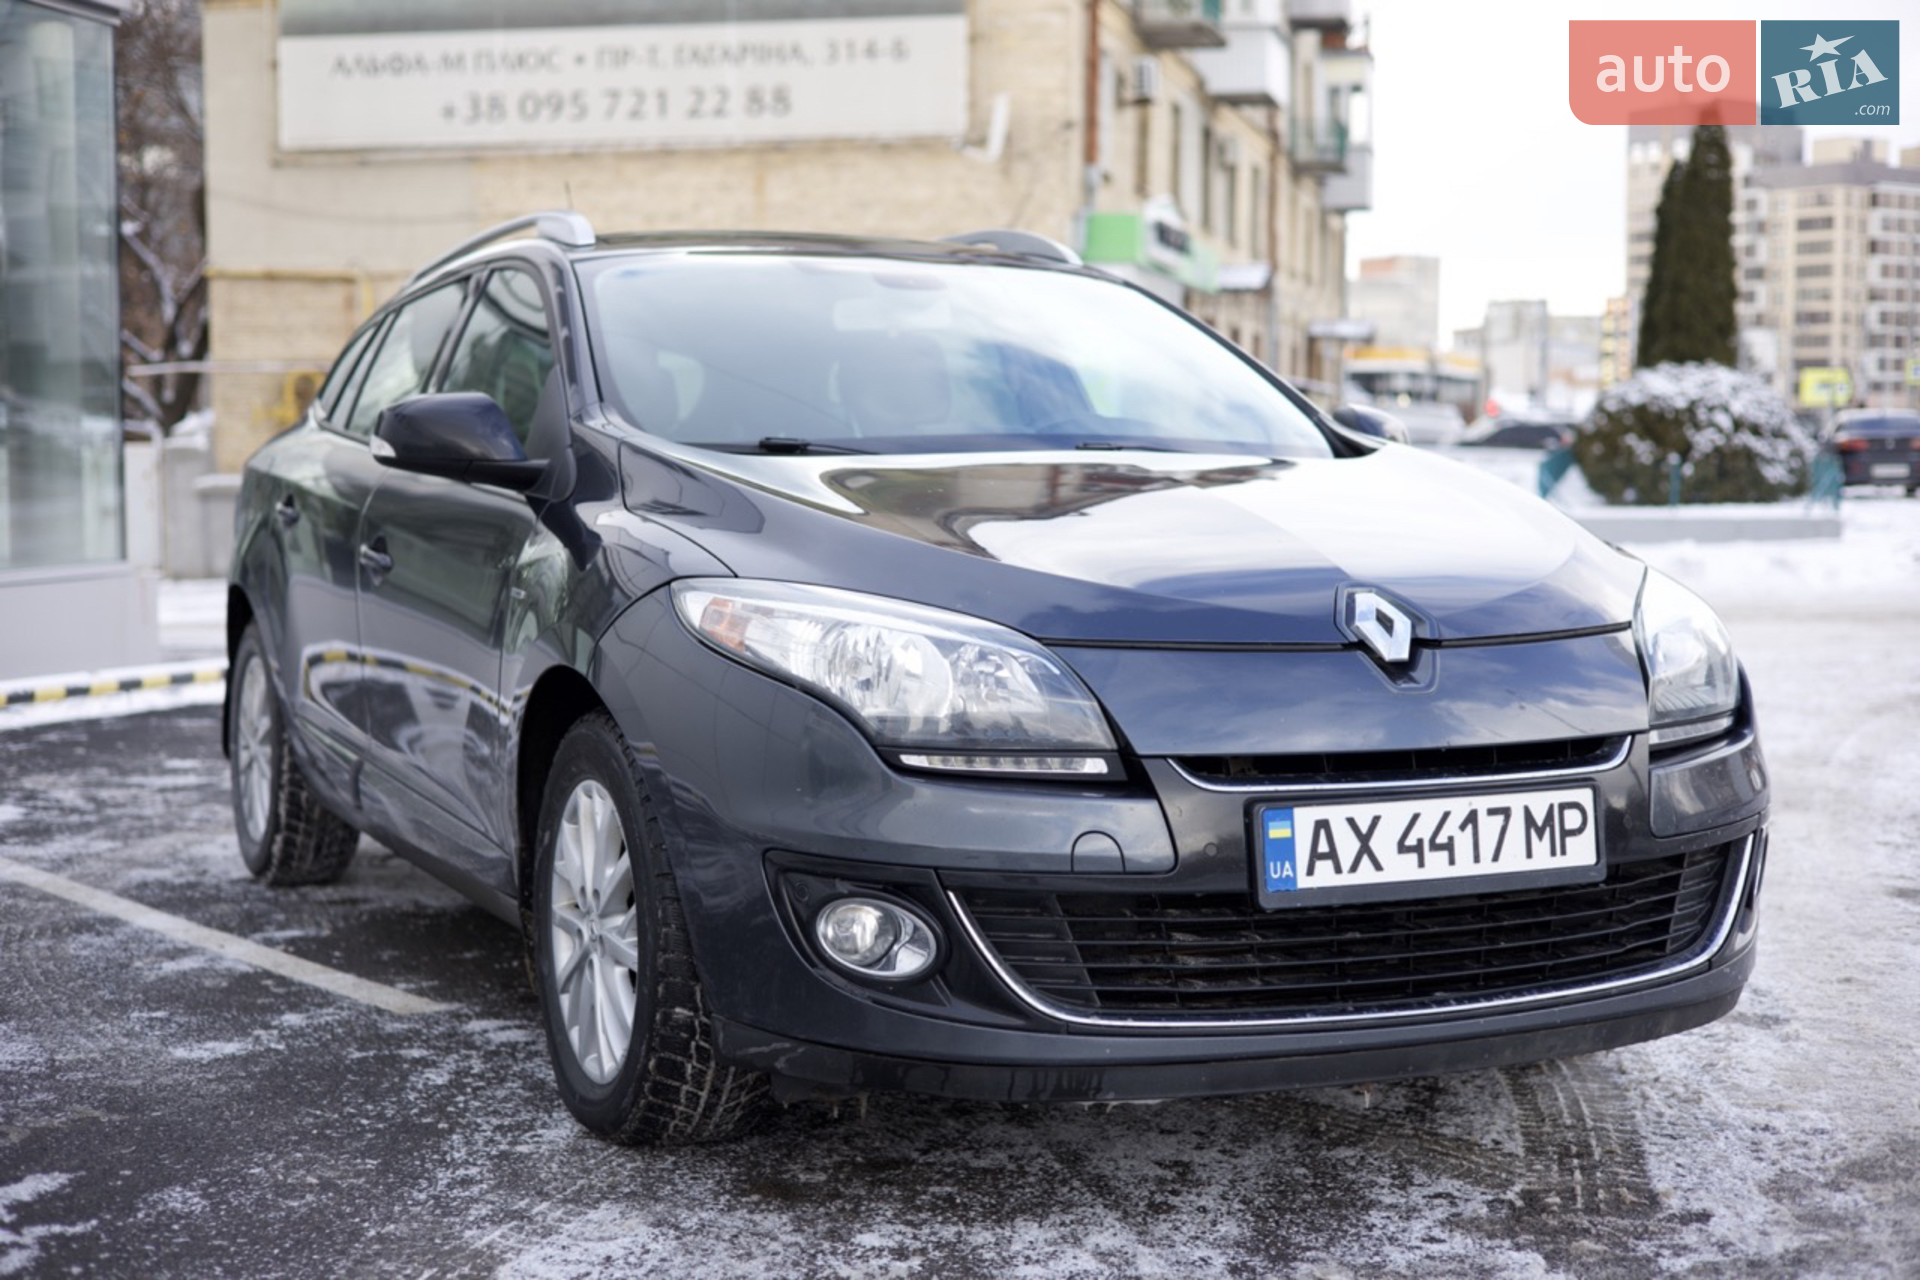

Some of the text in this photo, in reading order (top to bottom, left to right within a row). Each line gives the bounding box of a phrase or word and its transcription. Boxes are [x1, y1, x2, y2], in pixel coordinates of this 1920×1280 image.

[331, 52, 466, 79] АЛЬФА-М
[472, 47, 562, 74] ПЛЮС
[441, 83, 792, 125] +38 095 721 22 88
[1305, 801, 1588, 877] AX 4417 MP
[1269, 860, 1294, 879] UA
